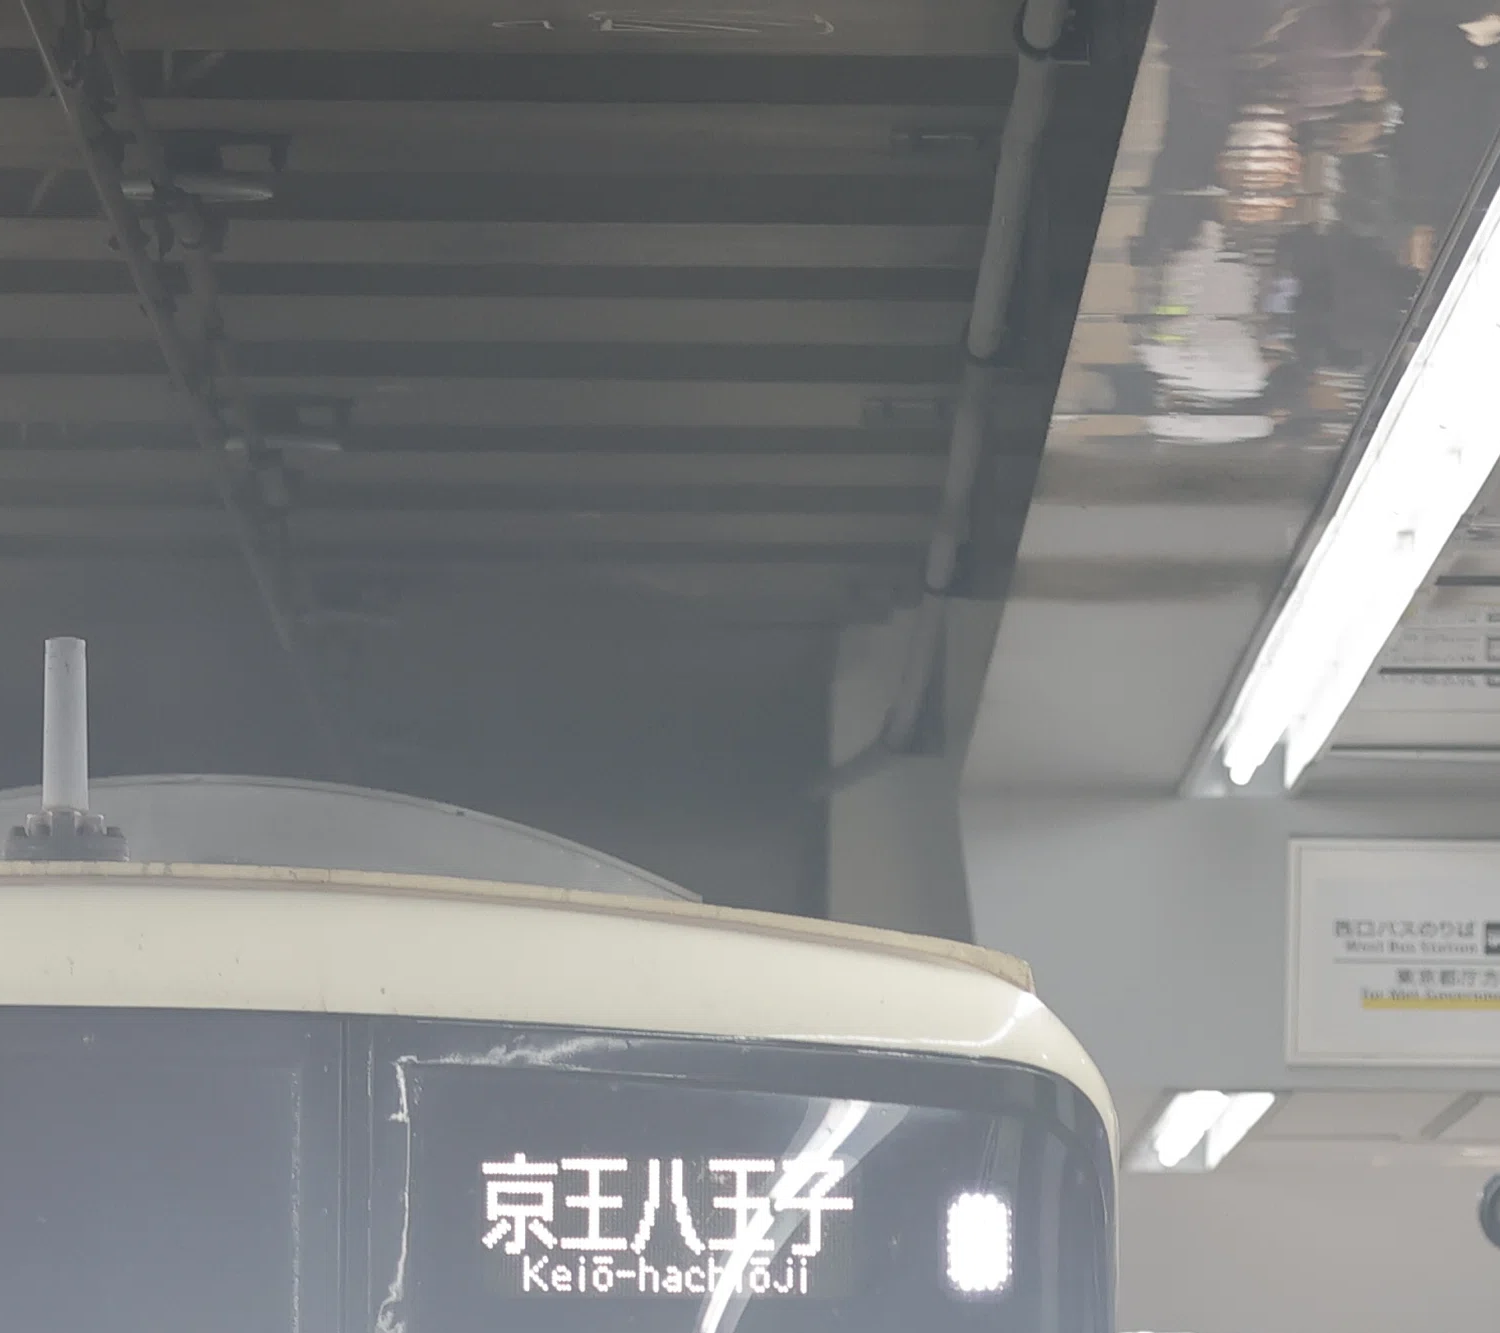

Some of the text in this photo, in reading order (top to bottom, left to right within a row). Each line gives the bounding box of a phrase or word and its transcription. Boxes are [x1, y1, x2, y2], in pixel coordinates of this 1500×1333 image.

[482, 1152, 854, 1256] 京王八王子
